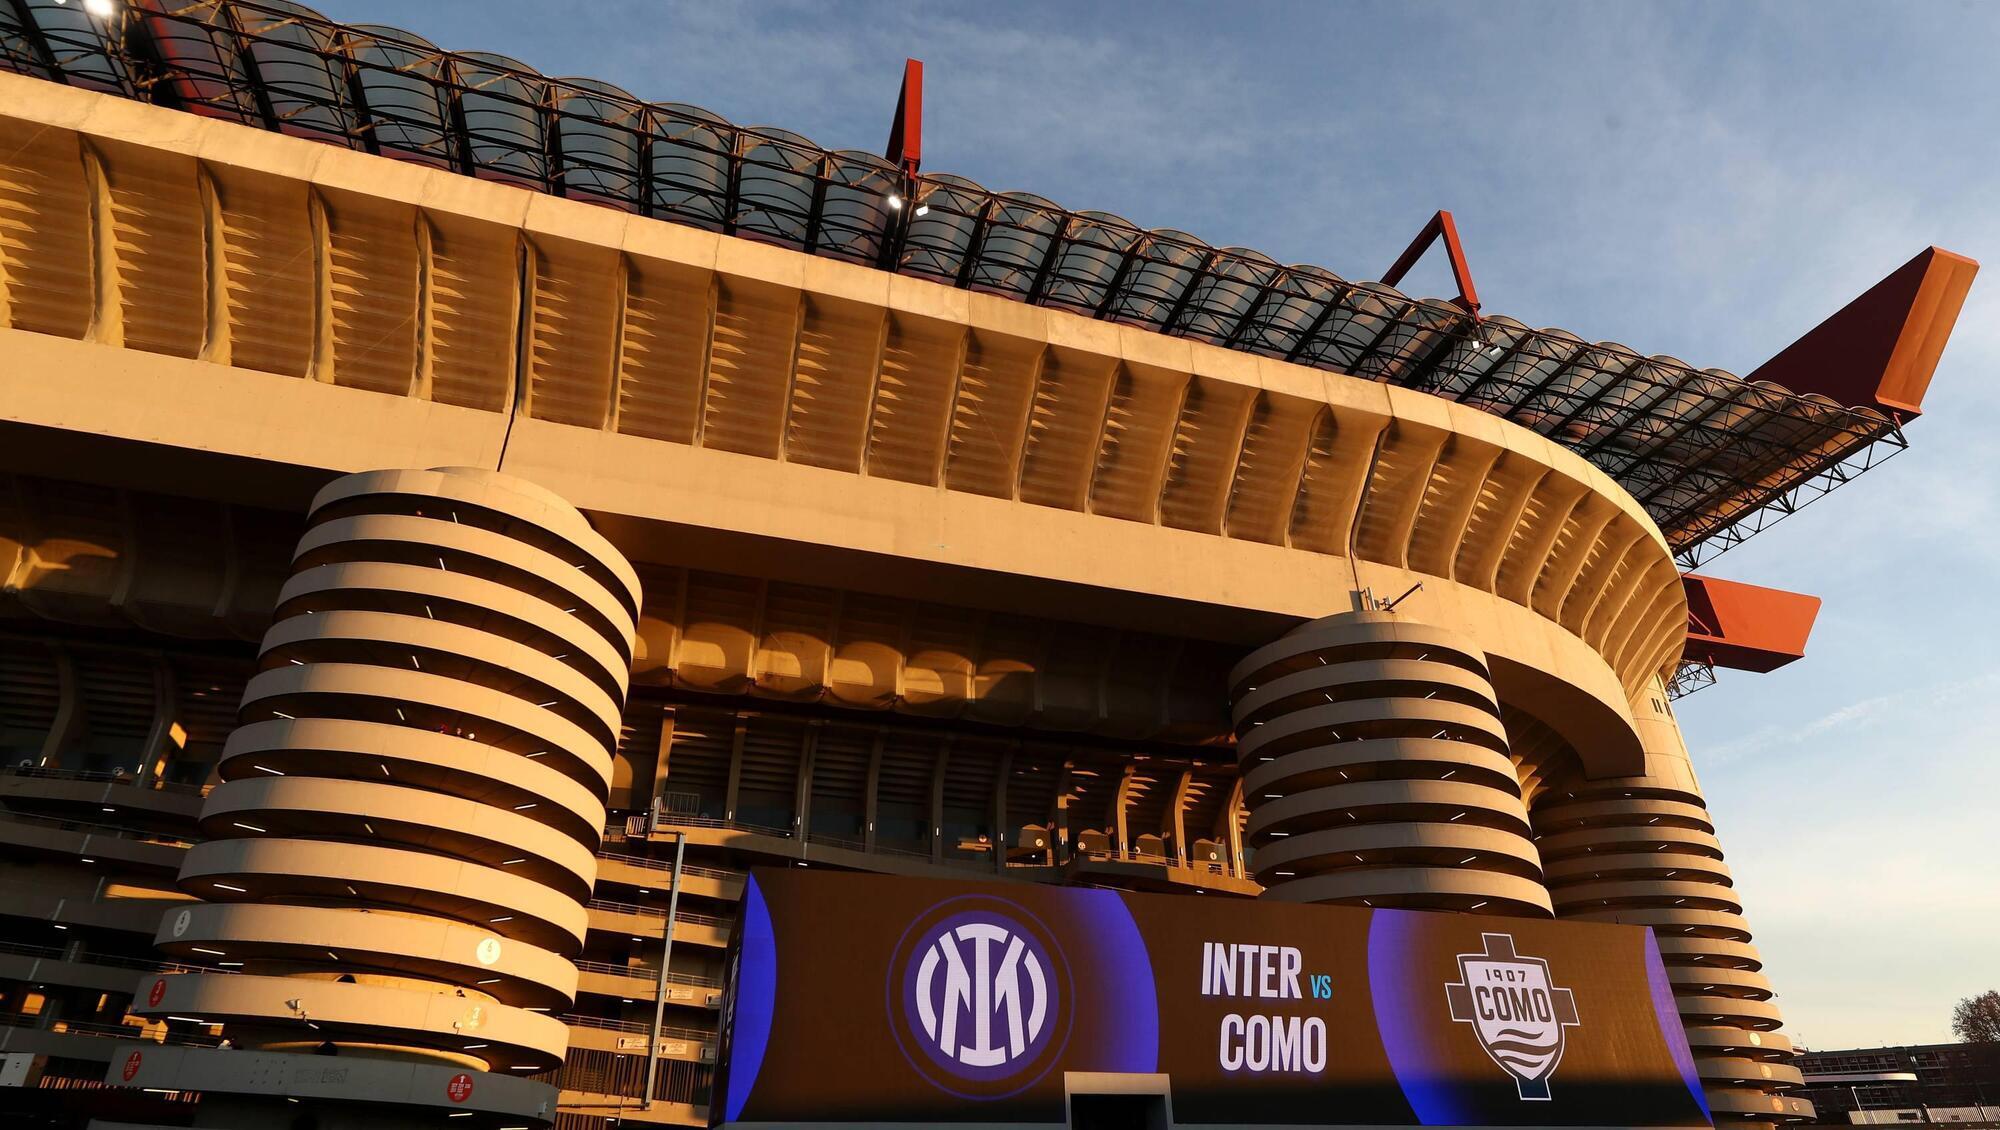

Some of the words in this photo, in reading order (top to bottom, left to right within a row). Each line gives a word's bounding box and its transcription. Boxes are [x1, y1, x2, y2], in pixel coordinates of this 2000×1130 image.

[1201, 942, 1303, 999] INTER
[1310, 975, 1332, 999] VS
[1485, 968, 1526, 983] 1907
[1475, 986, 1552, 1023] COMO
[1219, 1013, 1327, 1073] COMO
